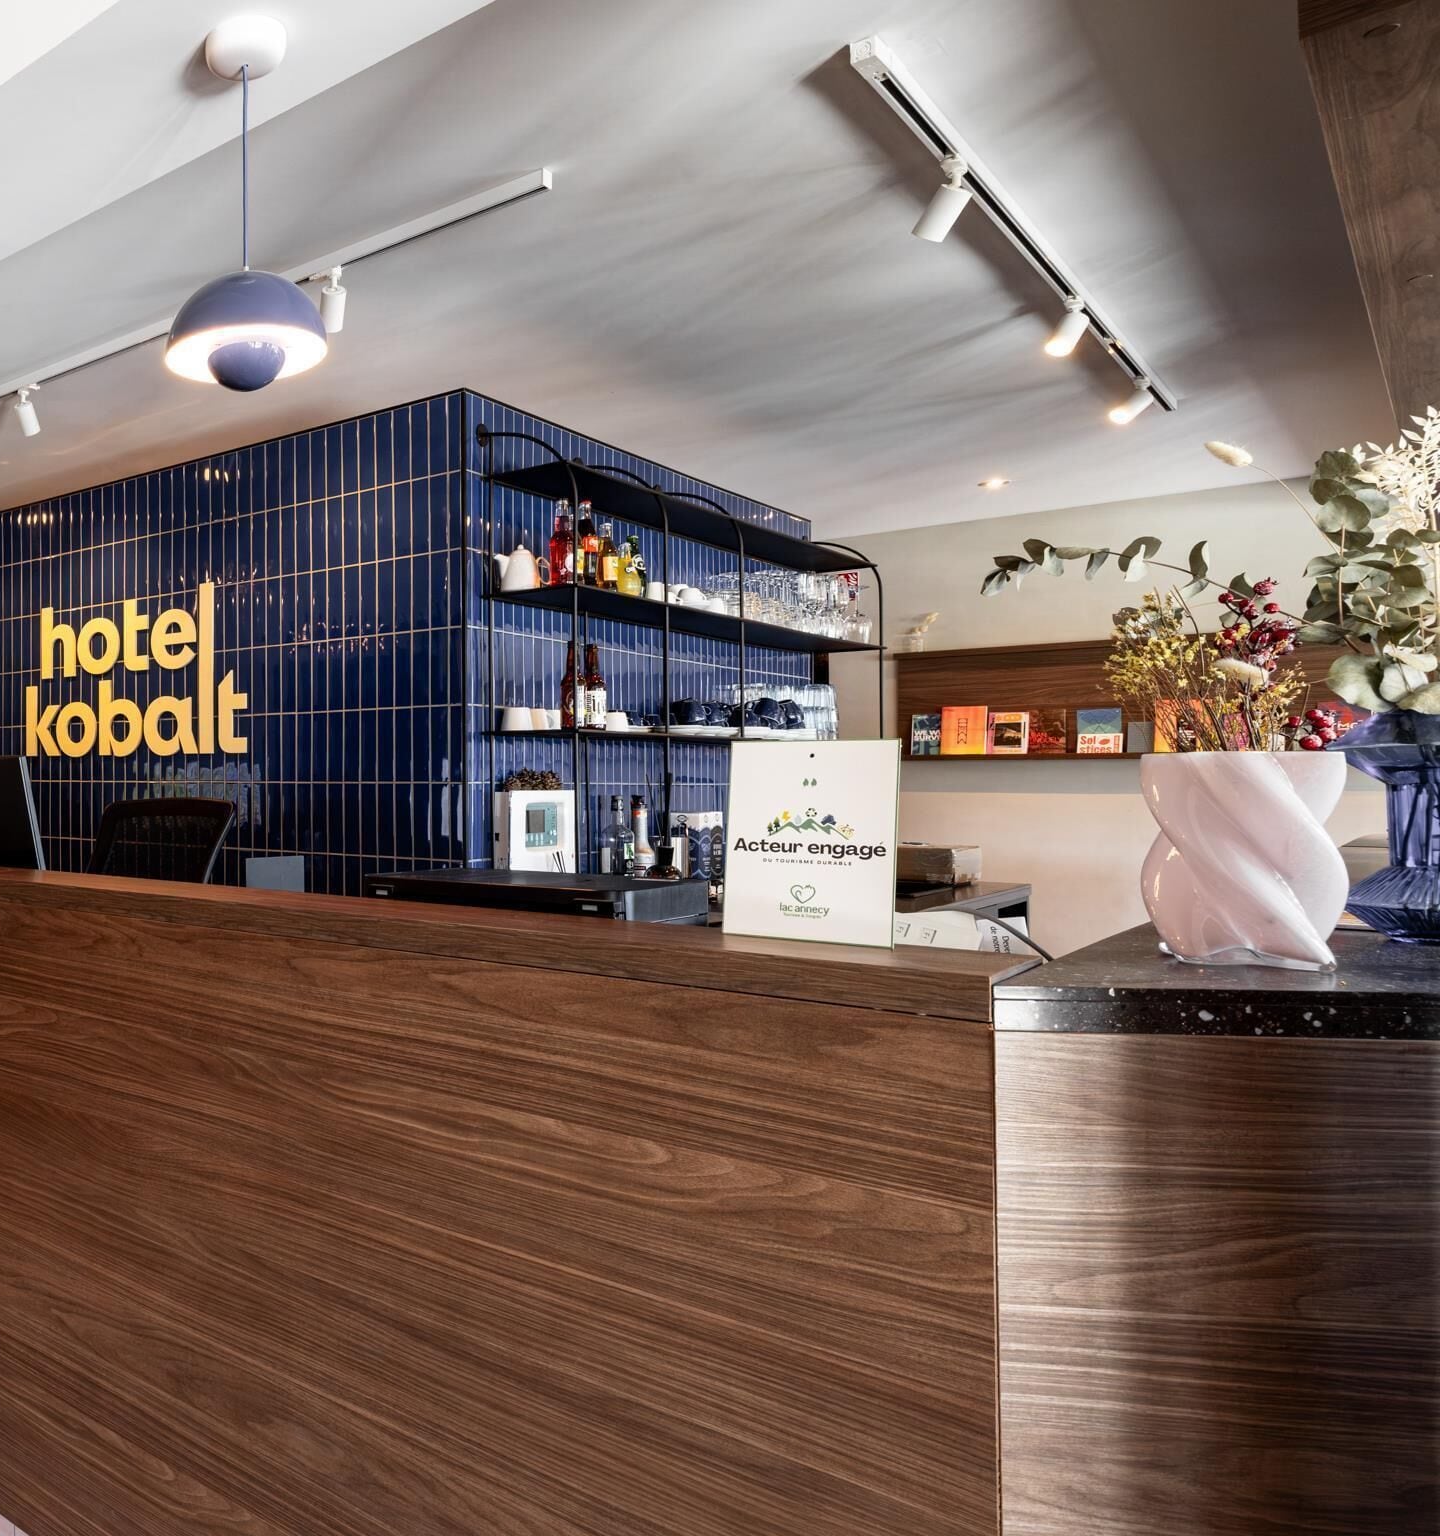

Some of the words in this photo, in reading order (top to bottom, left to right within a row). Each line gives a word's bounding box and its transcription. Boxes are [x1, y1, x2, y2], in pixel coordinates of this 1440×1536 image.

[40, 581, 215, 680] hotel
[25, 669, 248, 758] kobalt
[1080, 736, 1096, 745] Sol
[733, 838, 803, 854] Acteur
[807, 841, 887, 860] engagé
[779, 902, 793, 912] lac
[794, 905, 830, 917] annecy
